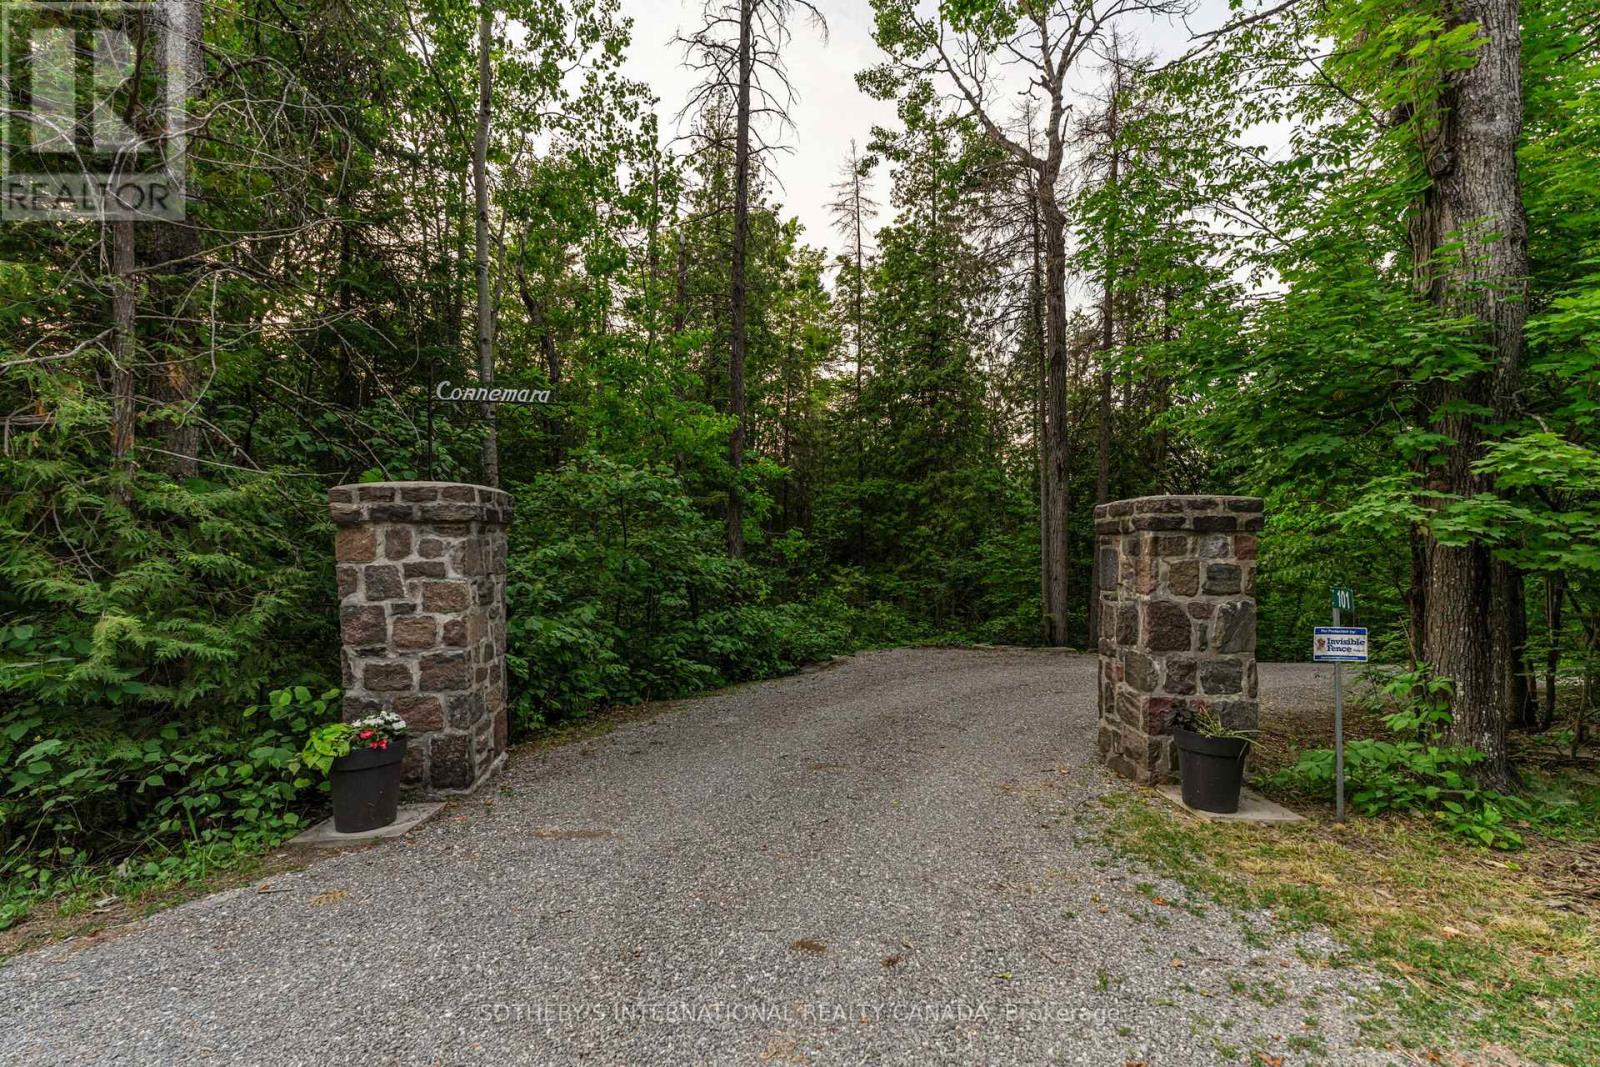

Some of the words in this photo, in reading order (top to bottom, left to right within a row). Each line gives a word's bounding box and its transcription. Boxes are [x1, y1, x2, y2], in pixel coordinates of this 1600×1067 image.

[436, 380, 551, 403] Connemara
[1337, 590, 1350, 609] 101
[1327, 638, 1366, 646] Invisible
